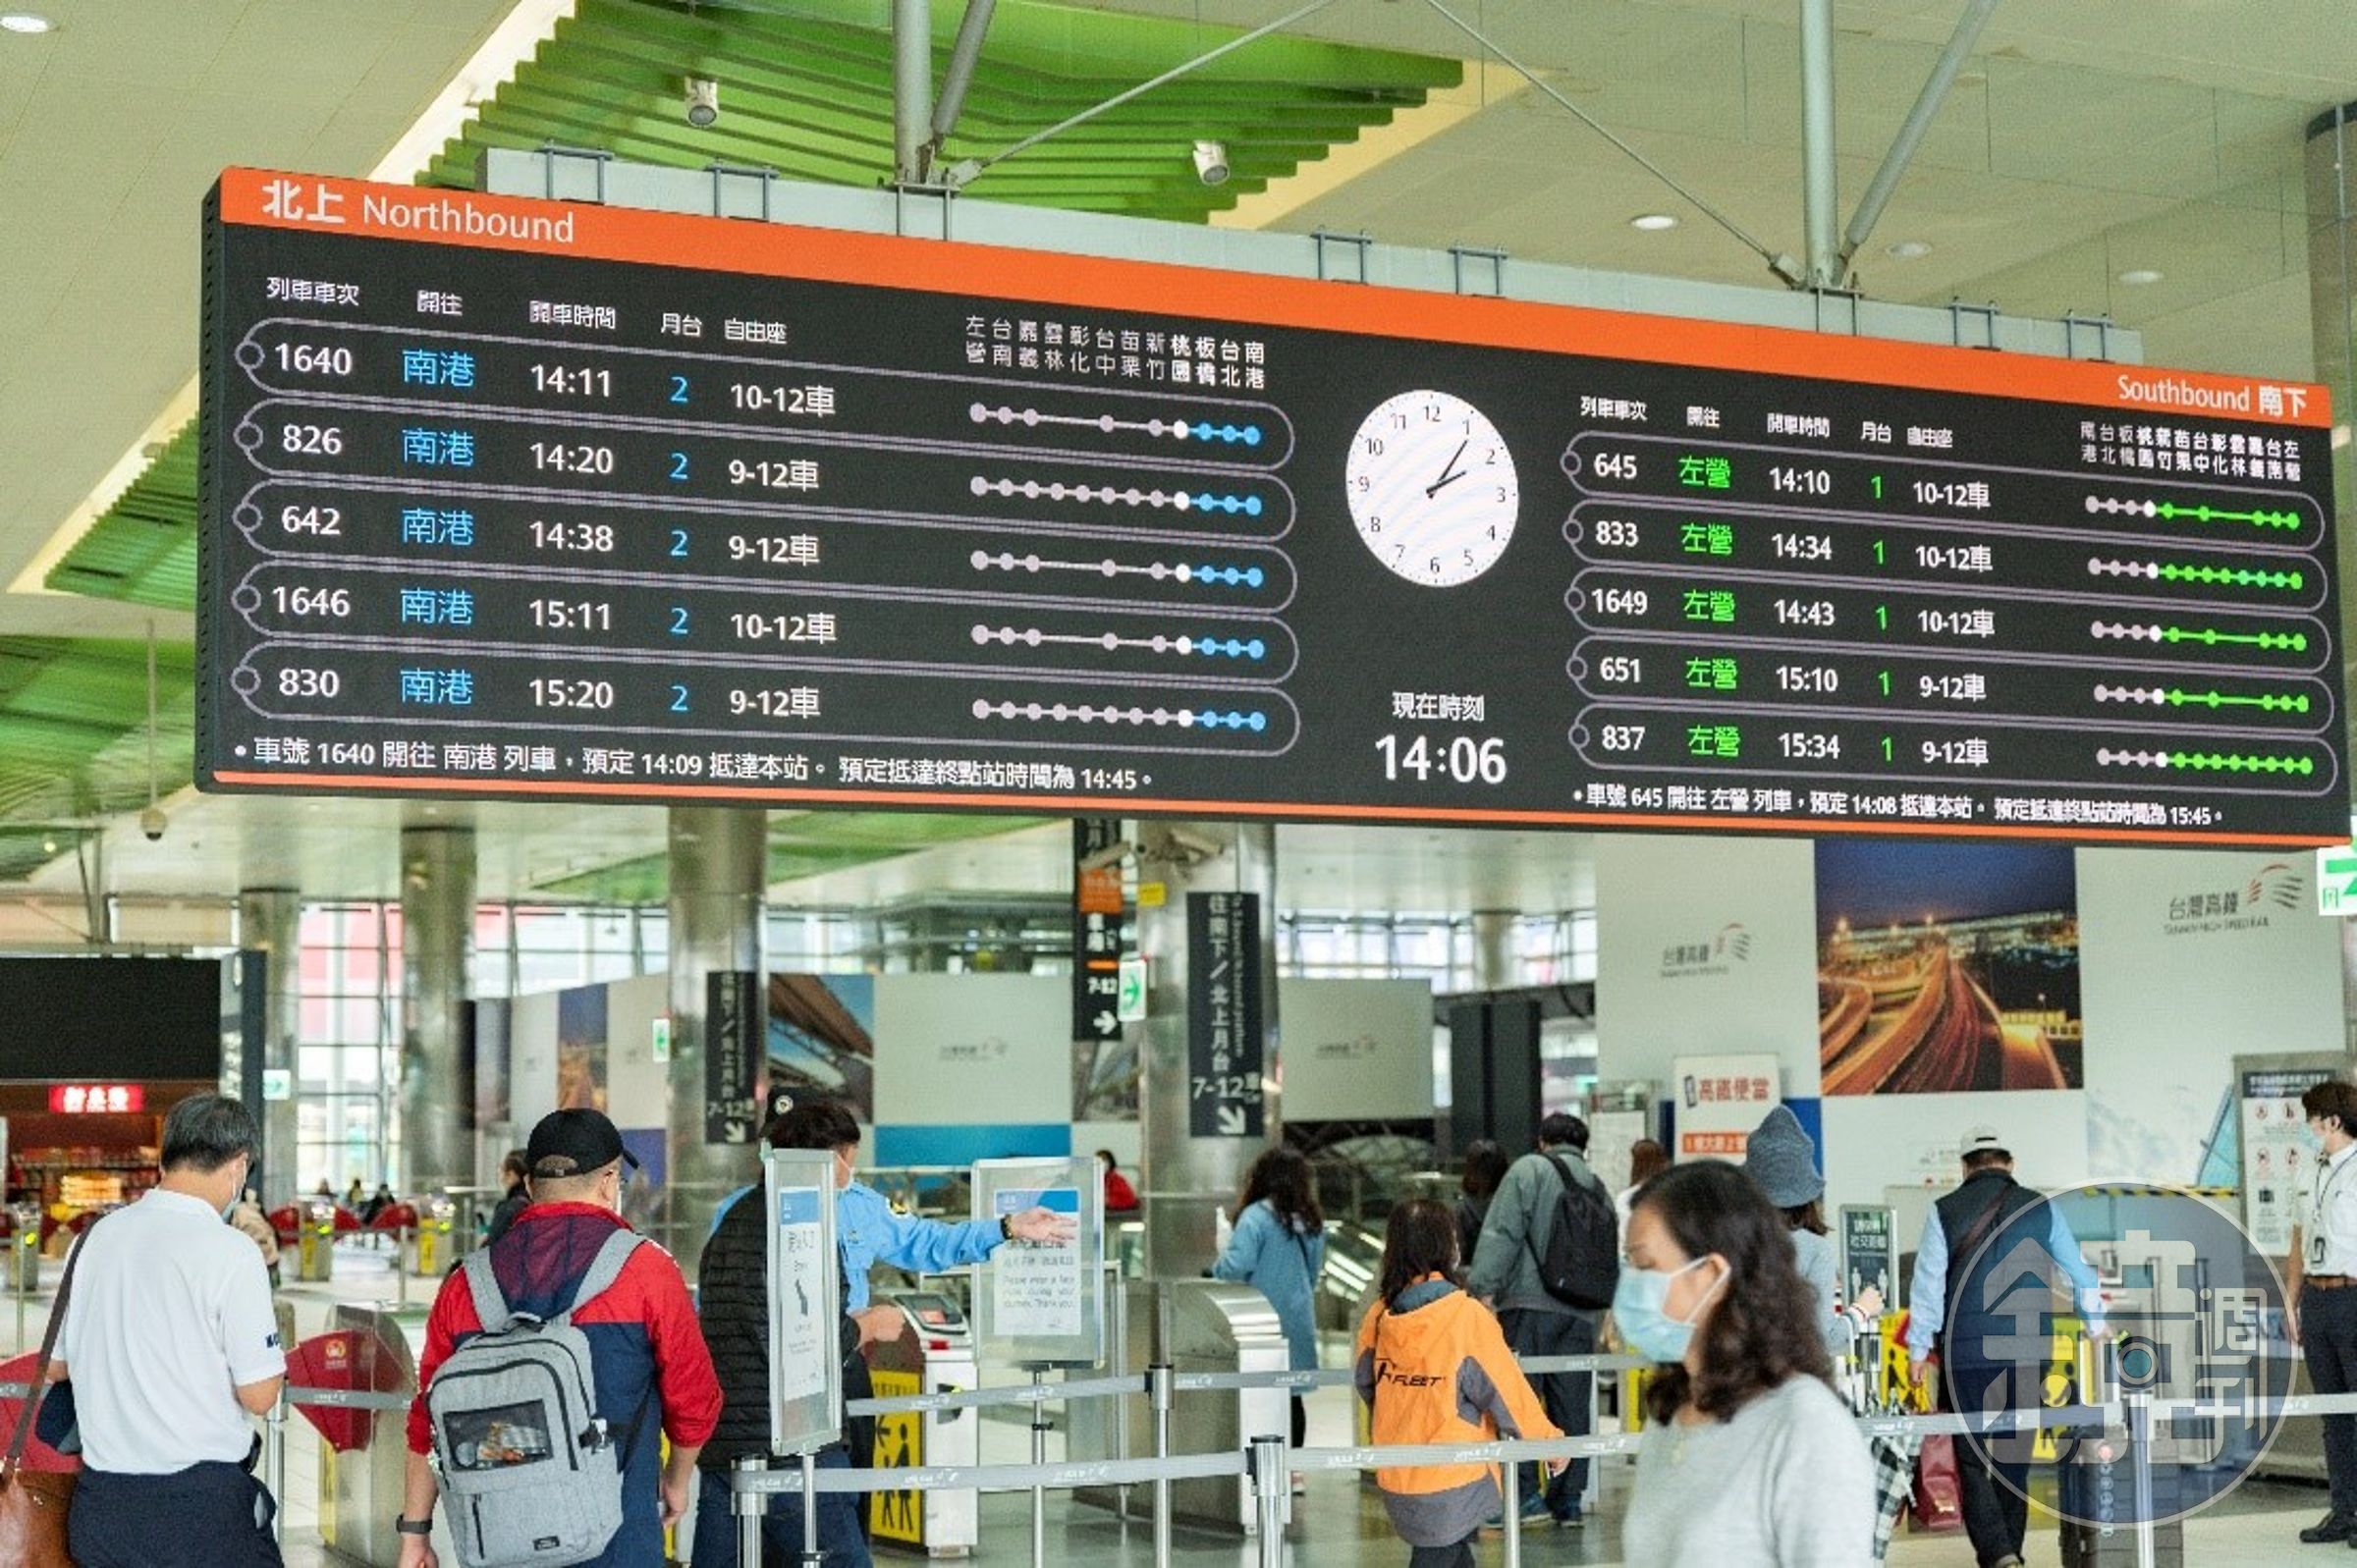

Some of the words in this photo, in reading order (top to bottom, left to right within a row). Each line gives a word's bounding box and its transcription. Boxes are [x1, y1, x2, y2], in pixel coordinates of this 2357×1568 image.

[262, 179, 346, 224] 北上
[363, 193, 574, 242] Northbound
[266, 277, 359, 306] 列車車次
[416, 290, 463, 316] 開往
[529, 299, 616, 330] 開車時間
[660, 312, 703, 338] 月台
[724, 317, 788, 345] 自由座
[274, 343, 353, 376] 1640
[402, 349, 475, 387] 南港
[530, 363, 610, 398] 14:11
[670, 376, 688, 404] 2
[731, 383, 836, 418] 10-12車
[2117, 375, 2250, 410] Southbound
[2258, 385, 2307, 417] 南下
[1391, 412, 1407, 430] 11
[1424, 406, 1442, 423] 12
[1462, 419, 1471, 436] 1
[1580, 396, 1648, 421] 列車車次
[1686, 406, 1721, 428] 開往
[1767, 412, 1831, 438] 開車時間
[1860, 420, 1891, 444] 月台
[1906, 425, 1953, 449] 自由座
[283, 423, 343, 456] 826
[402, 427, 474, 467] 南港
[529, 442, 614, 474] 14:20
[670, 453, 688, 480] 2
[728, 459, 819, 493] 9-12車
[1365, 438, 1384, 457] 10
[1485, 448, 1496, 465] 2
[1358, 475, 1371, 493] 9
[1497, 486, 1507, 504] 3
[1593, 453, 1637, 480] 645
[1678, 455, 1731, 489] 左營
[1769, 466, 1831, 495] 14:10
[1871, 475, 1882, 499] 1
[1913, 480, 1991, 510] 10-12車
[281, 506, 341, 536] 642
[402, 507, 473, 546] 南港
[529, 520, 614, 552] 14:38
[670, 529, 688, 557] 2
[728, 533, 820, 567] 9-12車
[1370, 516, 1382, 533] 8
[1486, 524, 1497, 541] 4
[1395, 544, 1406, 560] 7
[1430, 557, 1441, 573] 6
[1463, 550, 1474, 567] 5
[1595, 520, 1639, 548] 833
[1680, 522, 1733, 556] 左營
[1771, 533, 1833, 561] 14:34
[1873, 540, 1884, 565] 1
[1915, 544, 1994, 573] 10-12車
[272, 586, 351, 618] 1646
[400, 586, 474, 625] 南港
[529, 599, 610, 630] 15:11
[670, 607, 688, 634] 2
[731, 612, 838, 645] 10-12車
[1591, 588, 1648, 616] 1649
[1683, 588, 1735, 622] 左營
[1774, 599, 1836, 626] 14:43
[1875, 605, 1887, 630] 1
[1917, 609, 1996, 638] 10-12車
[279, 668, 340, 698] 830
[400, 667, 473, 705] 南港
[529, 678, 614, 709] 15:20
[671, 685, 688, 712] 2
[730, 685, 821, 720] 9-12車
[1600, 656, 1640, 683] 651
[1685, 656, 1738, 689] 左營
[1776, 665, 1838, 692] 15:10
[1878, 671, 1890, 696] 1
[1919, 673, 1987, 702] 9-12車
[1392, 691, 1485, 723] 現在時刻
[253, 736, 310, 765] 車號
[317, 742, 376, 766] 1640
[382, 740, 437, 769] 開往
[443, 742, 497, 771] 南港
[641, 753, 703, 777] 14:09
[708, 751, 826, 781] 抵達本站。
[837, 758, 1074, 789] 預定抵達終點站時間為
[1375, 733, 1507, 784] 14:06
[1602, 724, 1646, 751] 837
[1687, 725, 1741, 757] 左營
[1778, 732, 1840, 760] 15:34
[1881, 736, 1891, 762] 1
[1921, 736, 1990, 767] 9-12車
[1586, 783, 1627, 808] 車號
[1630, 787, 1664, 808] 645
[1667, 785, 1707, 810] 開往
[1710, 787, 1750, 812] 左營
[1851, 793, 1898, 815] 14:08
